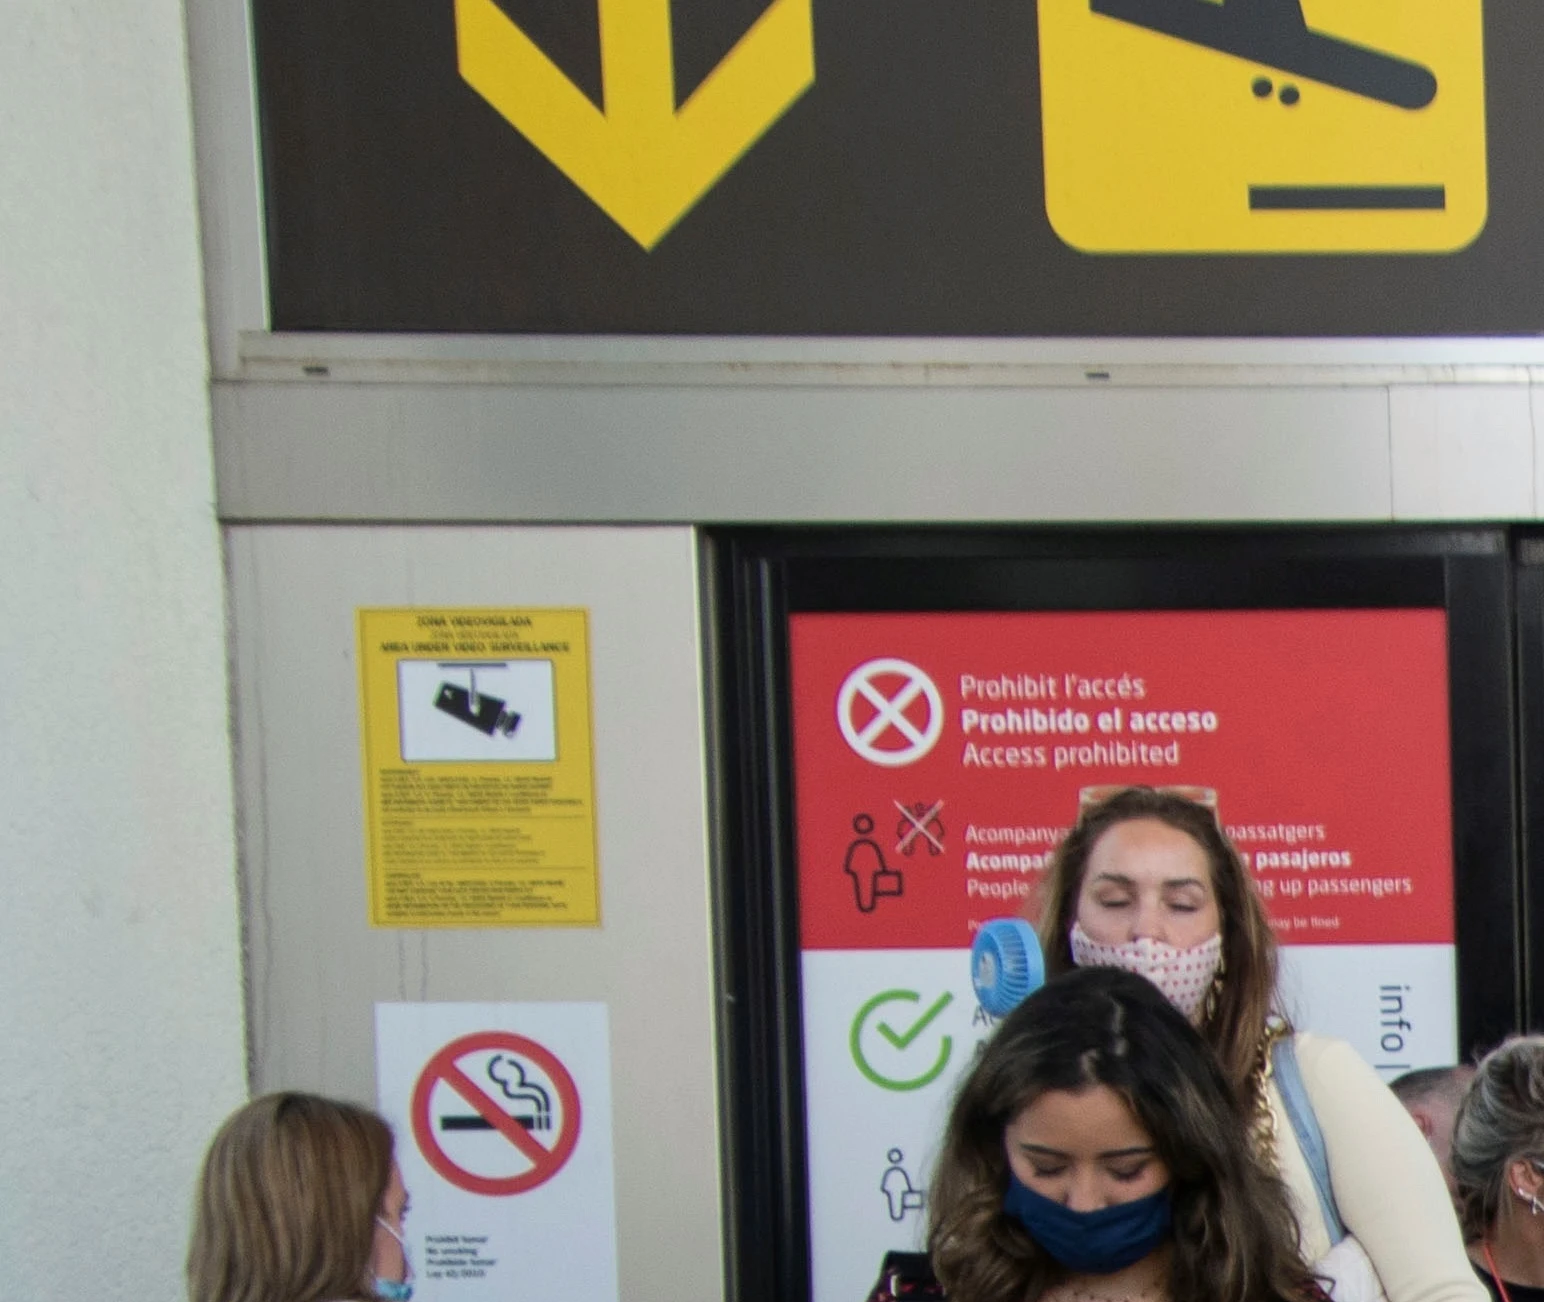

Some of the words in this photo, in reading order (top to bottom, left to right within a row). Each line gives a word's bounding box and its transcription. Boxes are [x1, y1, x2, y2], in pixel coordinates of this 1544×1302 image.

[960, 673, 1057, 700] Prohibit
[1065, 672, 1146, 700] l'accés
[961, 707, 1090, 735] Prohibido
[1098, 706, 1123, 733] el
[1129, 710, 1218, 733] acceso
[963, 742, 1047, 768] Access
[1054, 740, 1180, 771] prohibited
[1255, 847, 1352, 871] pasajeros
[966, 878, 1030, 901] People
[1279, 878, 1302, 899] up
[1307, 876, 1413, 899] passengers
[1379, 984, 1411, 1053] info
